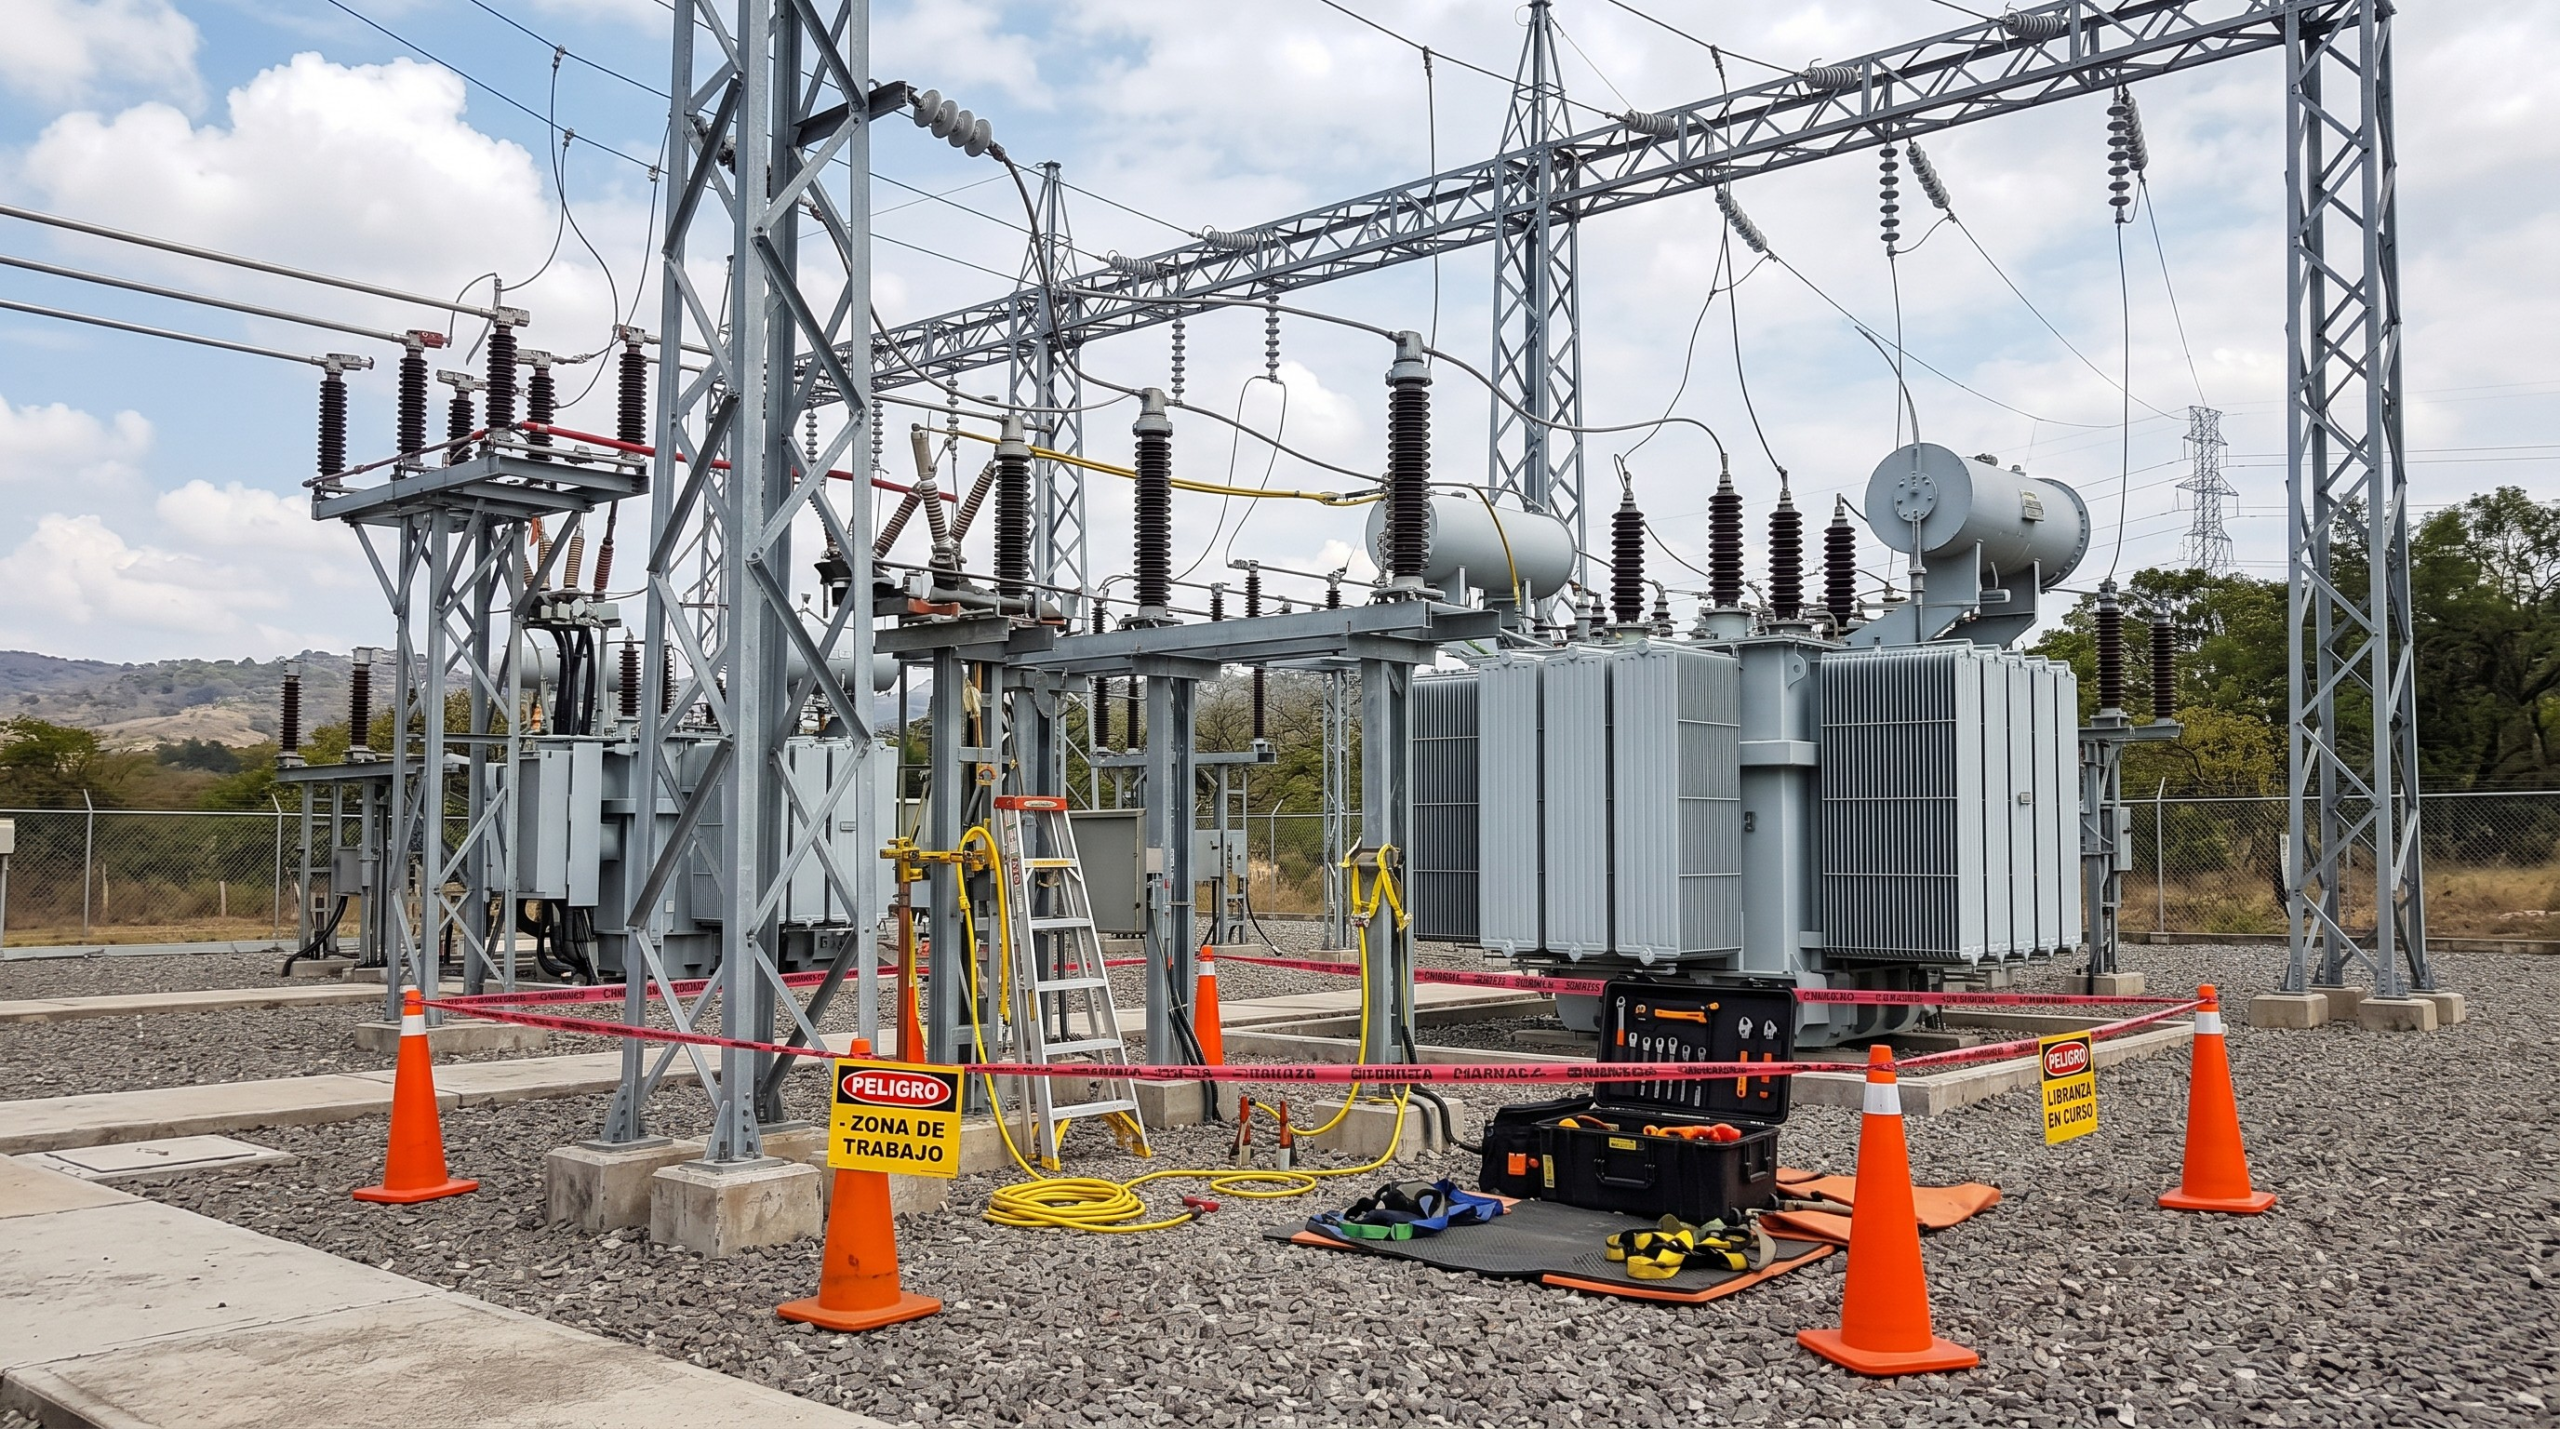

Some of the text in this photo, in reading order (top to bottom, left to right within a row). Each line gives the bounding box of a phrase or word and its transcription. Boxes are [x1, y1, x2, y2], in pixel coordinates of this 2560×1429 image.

[2048, 1048, 2086, 1070] PELIGRO
[851, 1077, 939, 1099] PELIGRO
[2047, 1082, 2091, 1106] LIBRANZA
[851, 1115, 909, 1135] ZONA
[917, 1121, 944, 1138] DE
[2048, 1103, 2093, 1128] EN CURSO
[843, 1139, 943, 1162] TRABAJO
